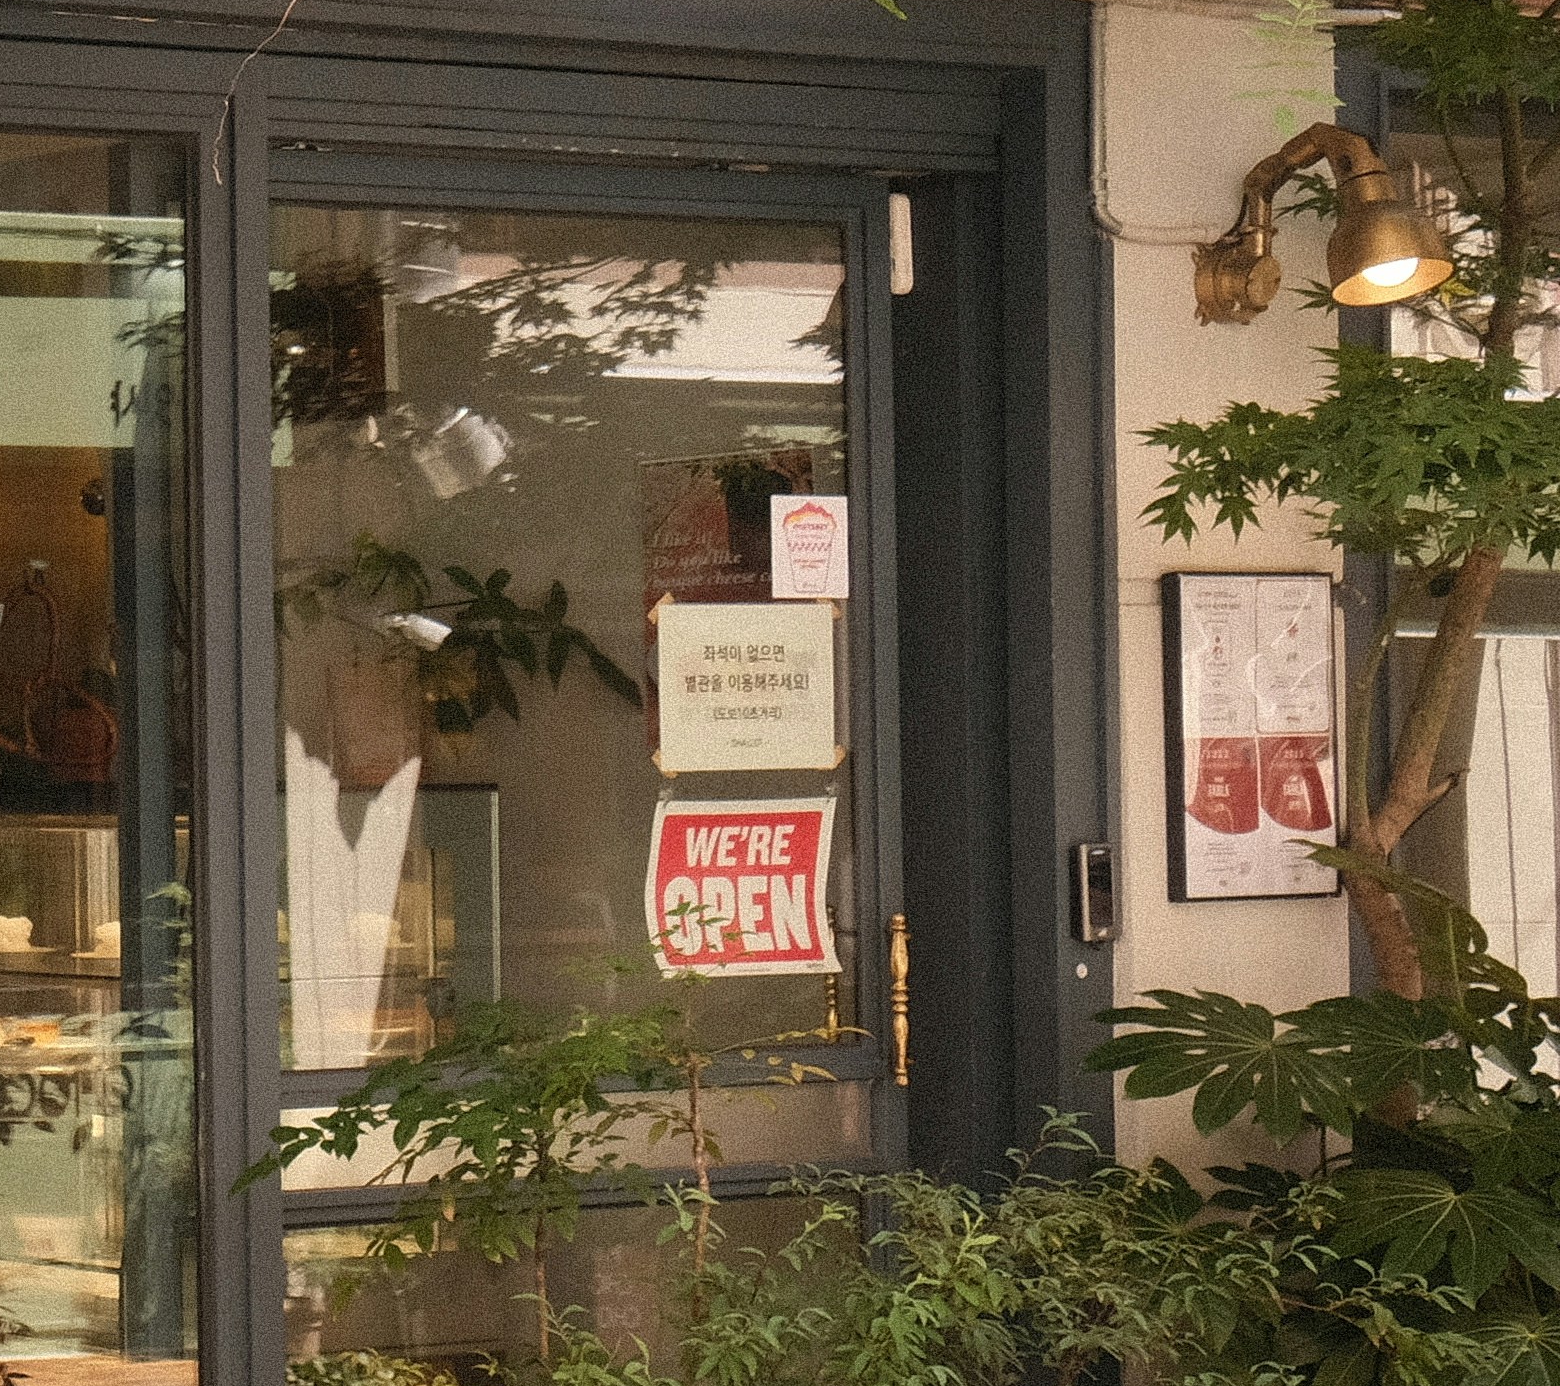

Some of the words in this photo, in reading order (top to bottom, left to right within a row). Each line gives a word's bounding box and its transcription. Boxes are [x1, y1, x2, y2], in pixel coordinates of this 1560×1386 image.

[704, 645, 742, 663] 좌석이
[747, 644, 785, 663] 없으면
[685, 674, 723, 694] 별관을
[728, 673, 809, 693] 이용해주세요!
[686, 825, 795, 867] WE'RE
[664, 875, 813, 956] OPEN
